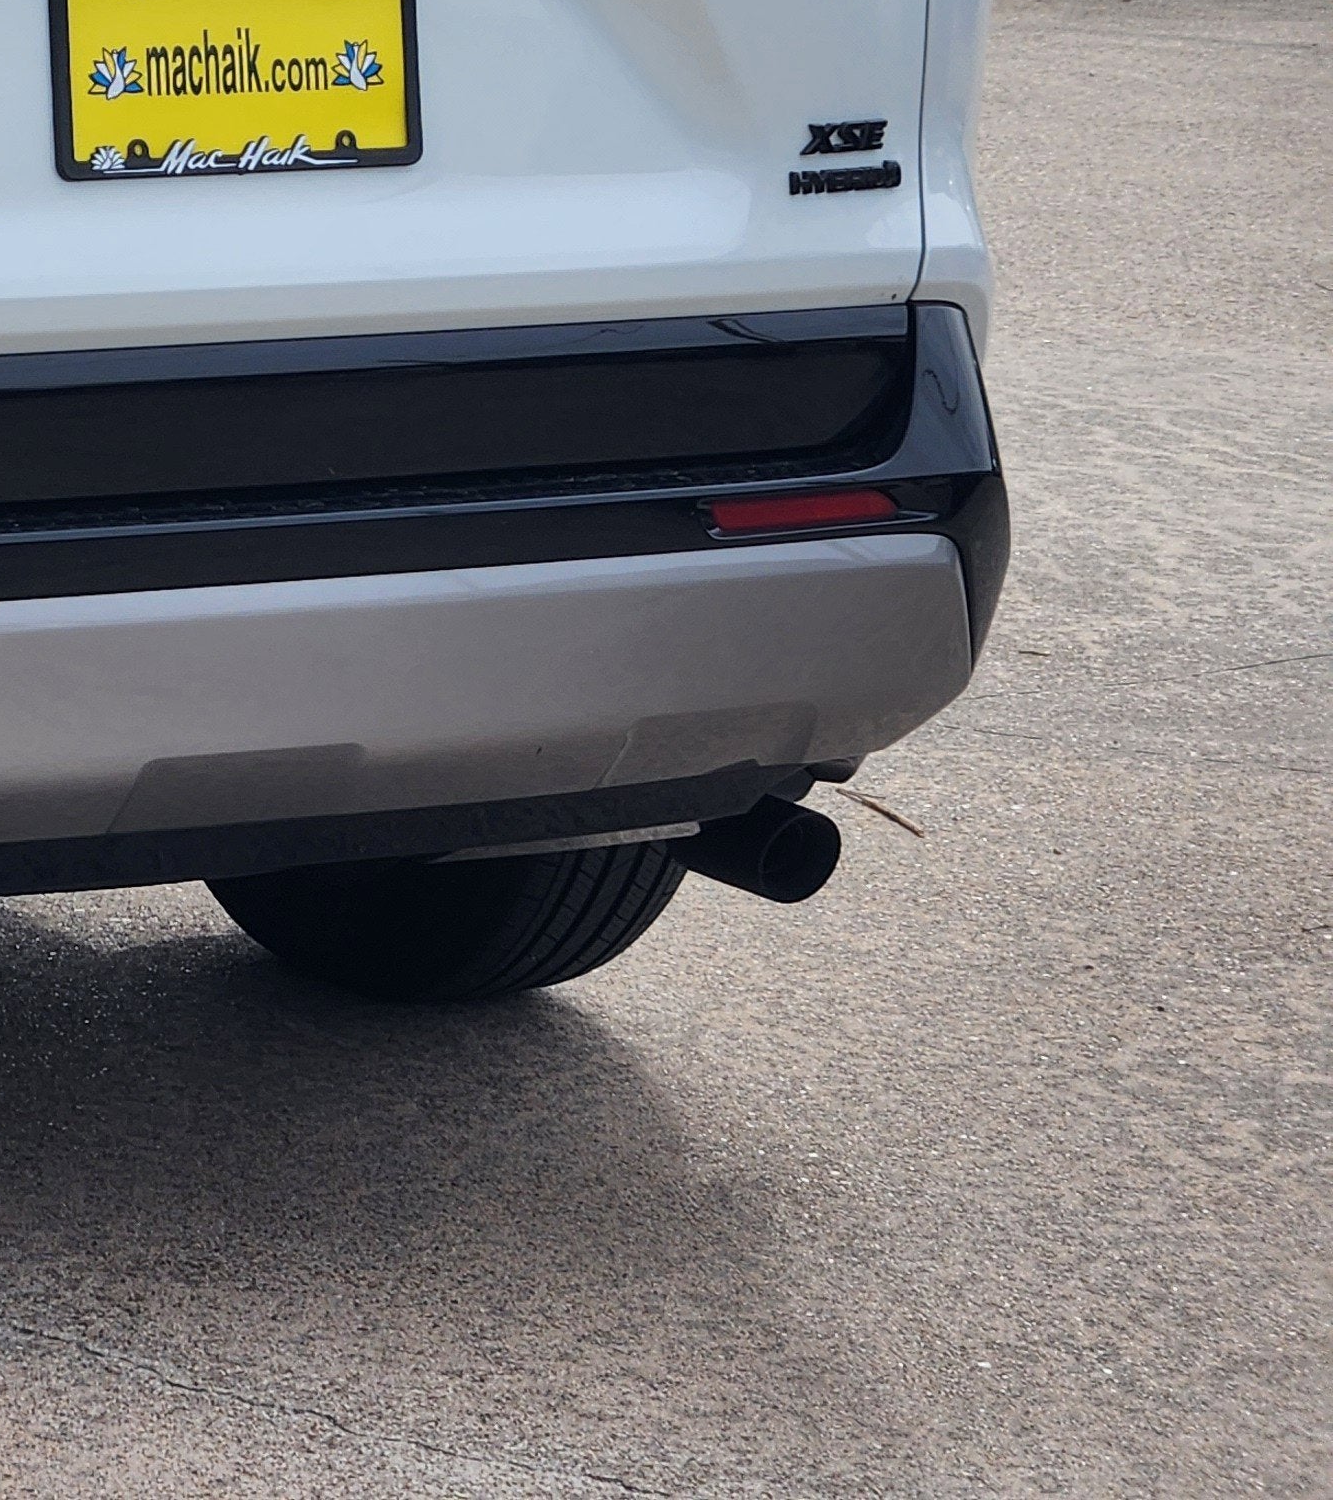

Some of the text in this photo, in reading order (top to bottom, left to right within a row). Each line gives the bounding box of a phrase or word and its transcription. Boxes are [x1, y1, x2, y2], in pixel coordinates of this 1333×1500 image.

[146, 28, 329, 97] machaik.com
[159, 134, 323, 175] Mac Haik
[799, 119, 888, 156] XSE
[789, 159, 902, 195] HYBRID
